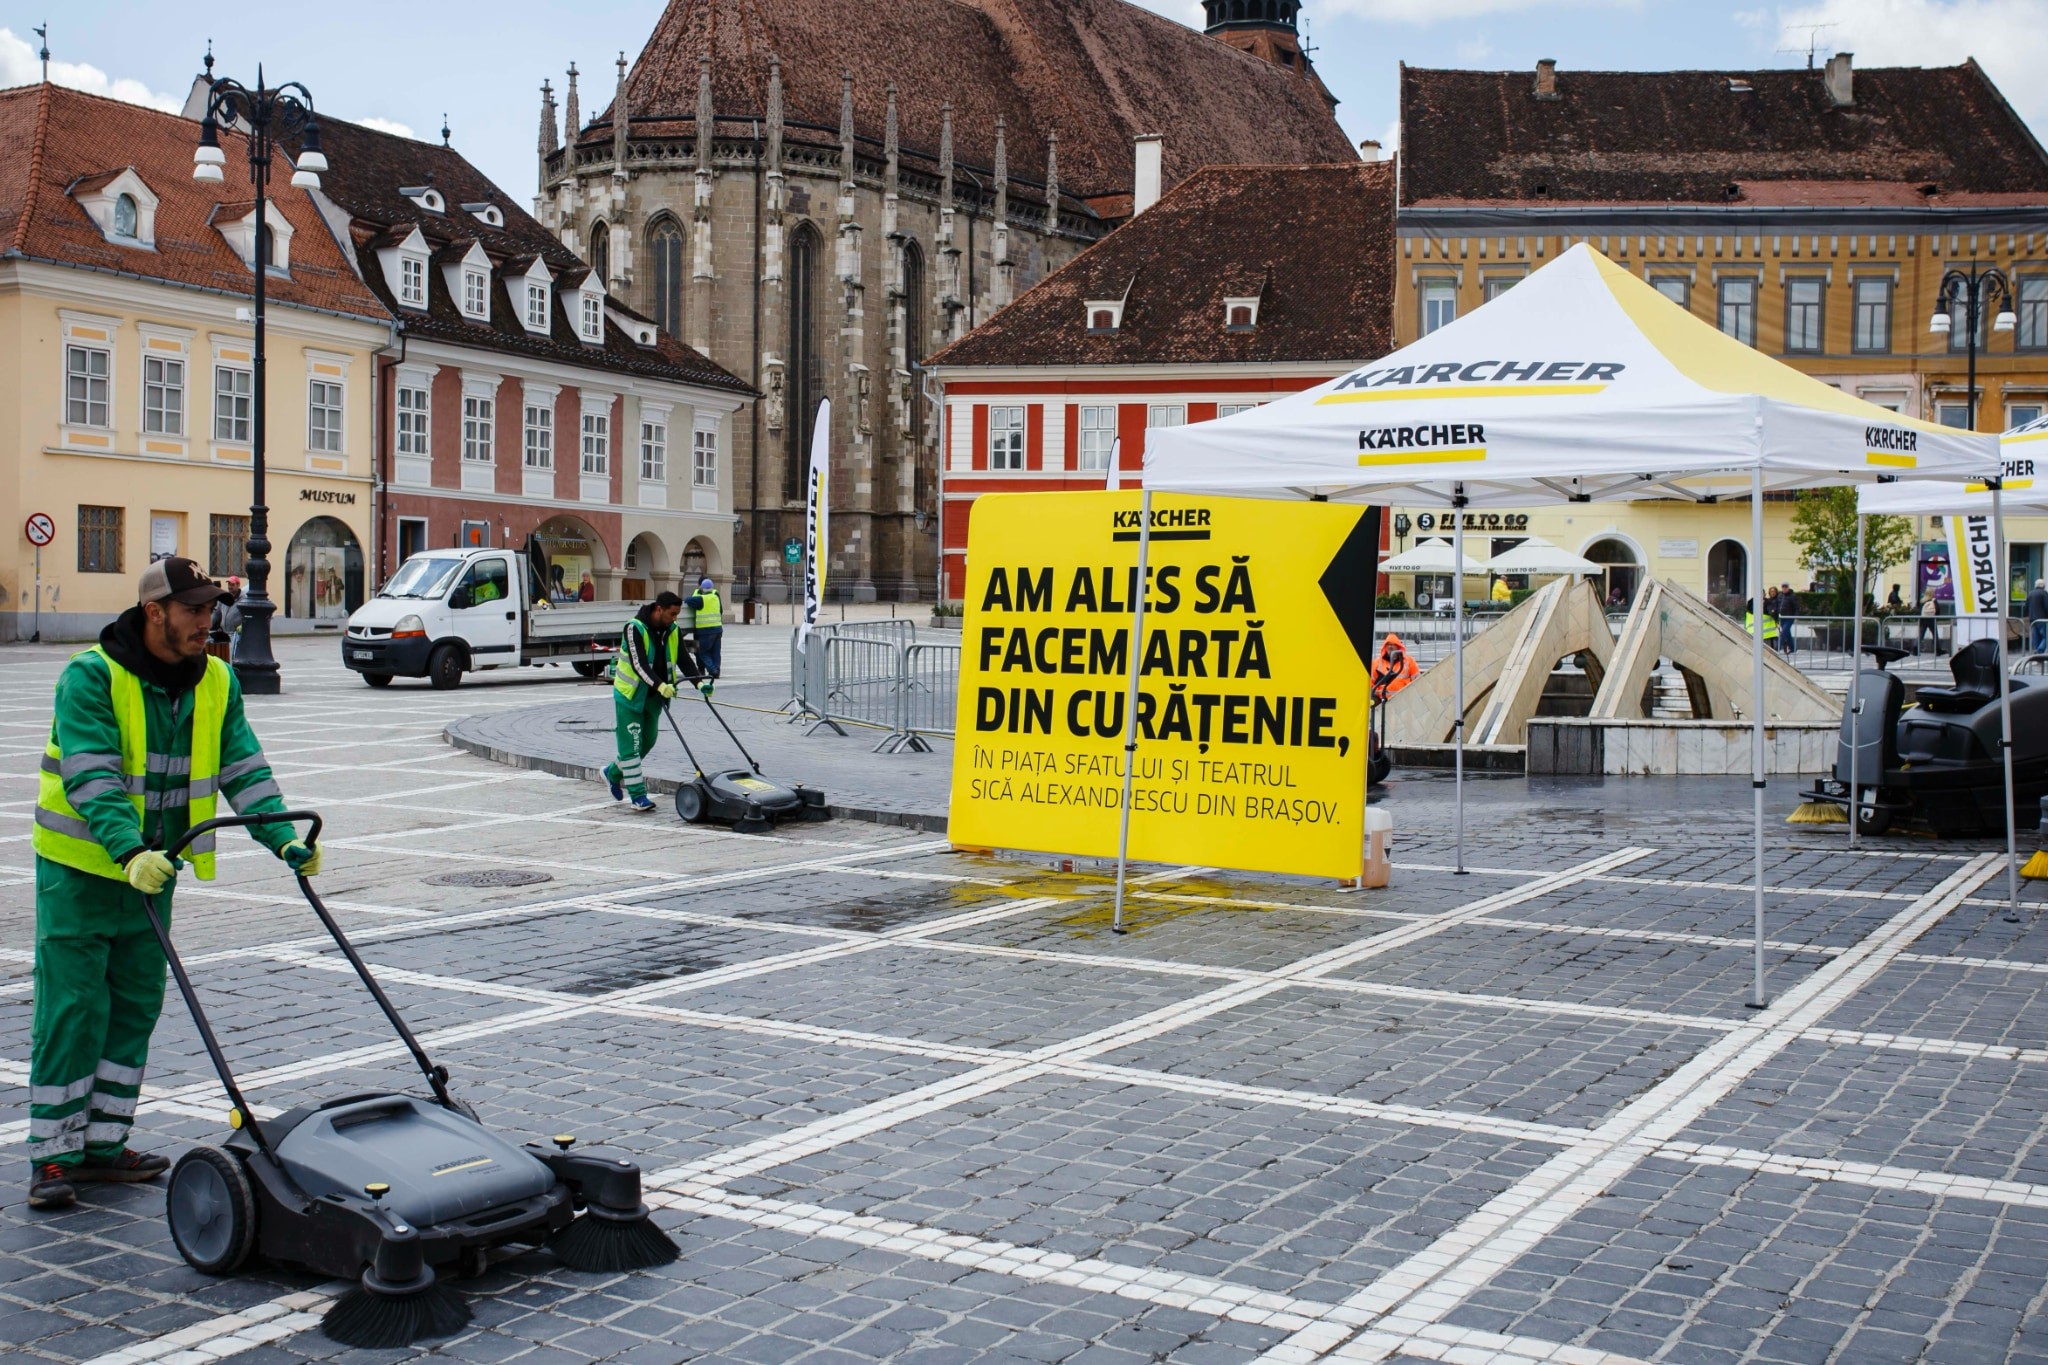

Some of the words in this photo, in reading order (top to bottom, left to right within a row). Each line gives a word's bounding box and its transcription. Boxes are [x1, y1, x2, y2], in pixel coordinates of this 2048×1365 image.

[1333, 361, 1626, 391] KÄRCHER
[1359, 424, 1487, 450] KÄRCHER
[1865, 426, 1917, 451] KÄRCHER
[299, 489, 356, 505] MUSEUM
[1113, 508, 1211, 528] KÄRCHER
[1422, 514, 1431, 526] 5
[1479, 513, 1500, 525] TO
[1504, 513, 1529, 525] GO
[981, 567, 1054, 613] AM
[1065, 565, 1181, 614] ALES
[1194, 555, 1256, 615] SĂ
[979, 627, 1129, 676] FACEM
[1139, 620, 1271, 679] ARTĂ
[976, 687, 1054, 735] DIN
[1067, 683, 1350, 758] CURĂȚENIE,
[973, 744, 994, 769] ÎN
[1001, 750, 1057, 777] PIAȚA
[1171, 759, 1189, 785] ȘI
[1198, 760, 1297, 788] TEATRUL
[970, 776, 1013, 801] SICĂ
[1020, 782, 1188, 814] ALEXANDRESCU
[1197, 793, 1236, 817] DIN
[1245, 796, 1340, 826] BRAȘOV.
